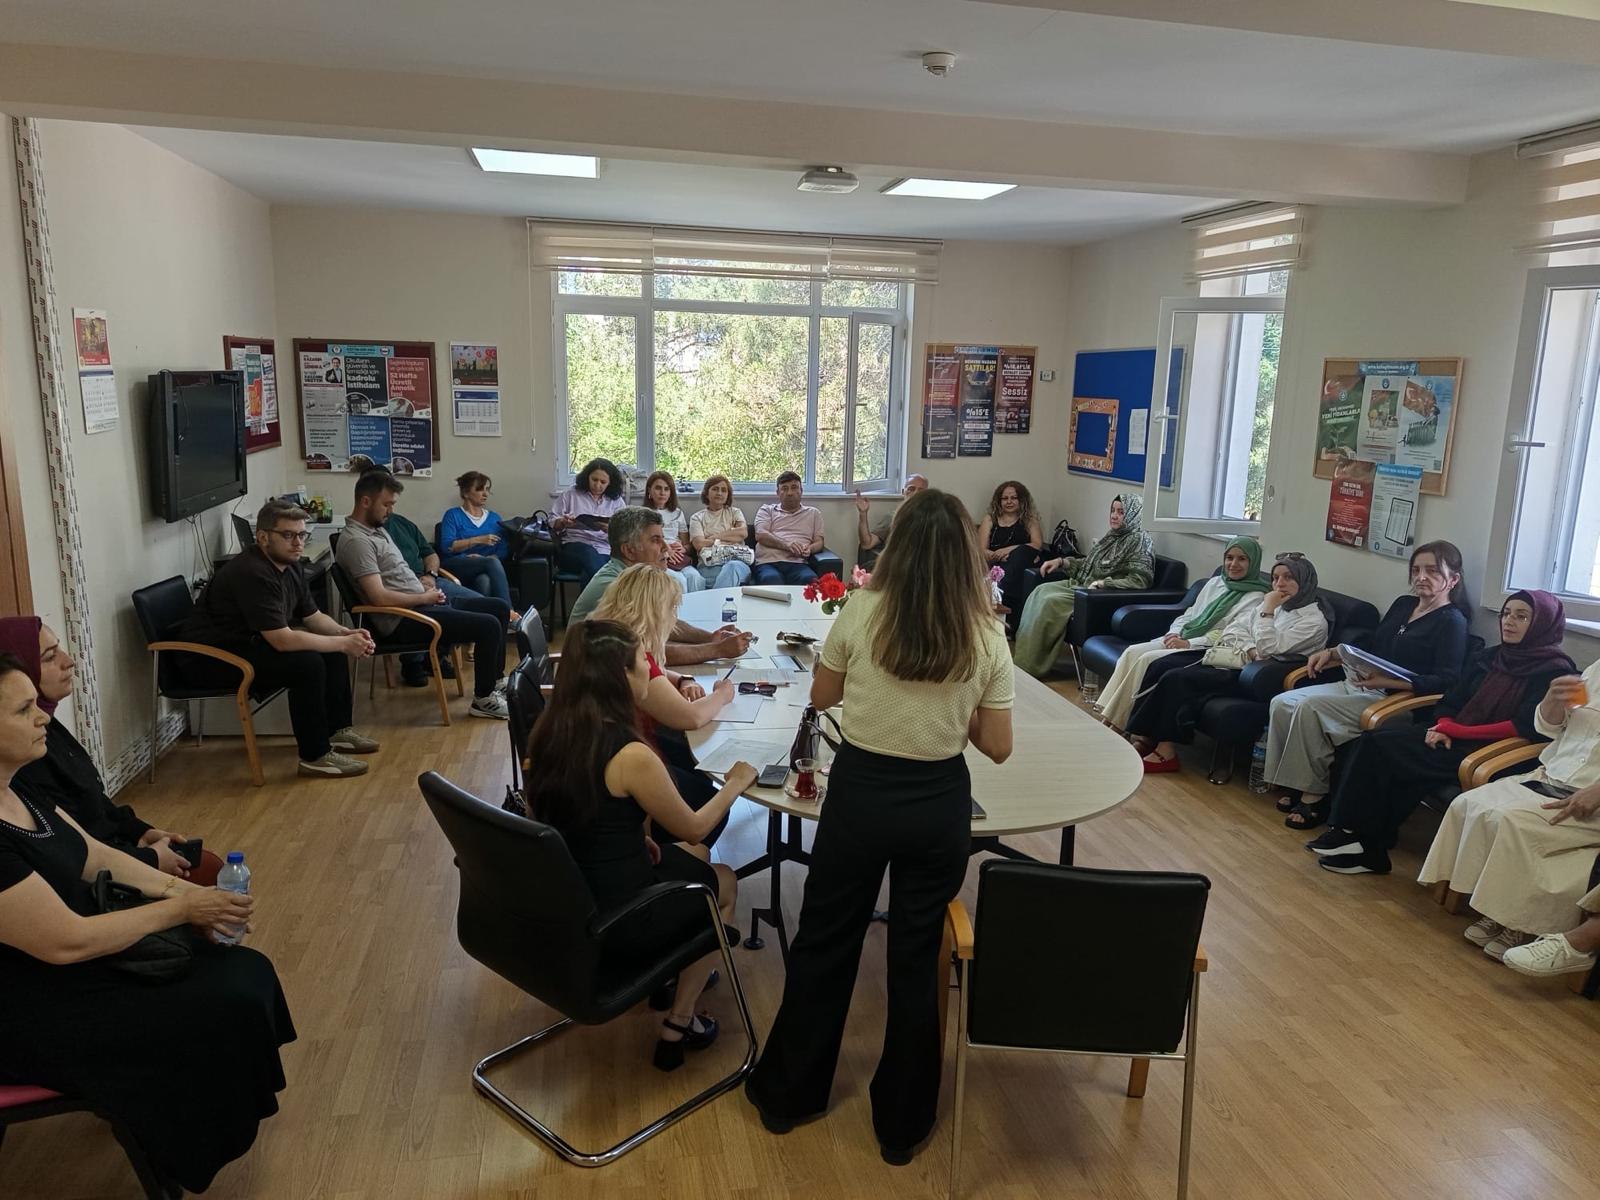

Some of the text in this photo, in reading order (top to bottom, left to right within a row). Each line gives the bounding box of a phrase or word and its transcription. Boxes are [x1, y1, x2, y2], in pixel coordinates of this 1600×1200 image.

[347, 381, 380, 389] istihdam
[1002, 387, 1027, 396] Sessiz
[966, 408, 989, 416] %15'E
